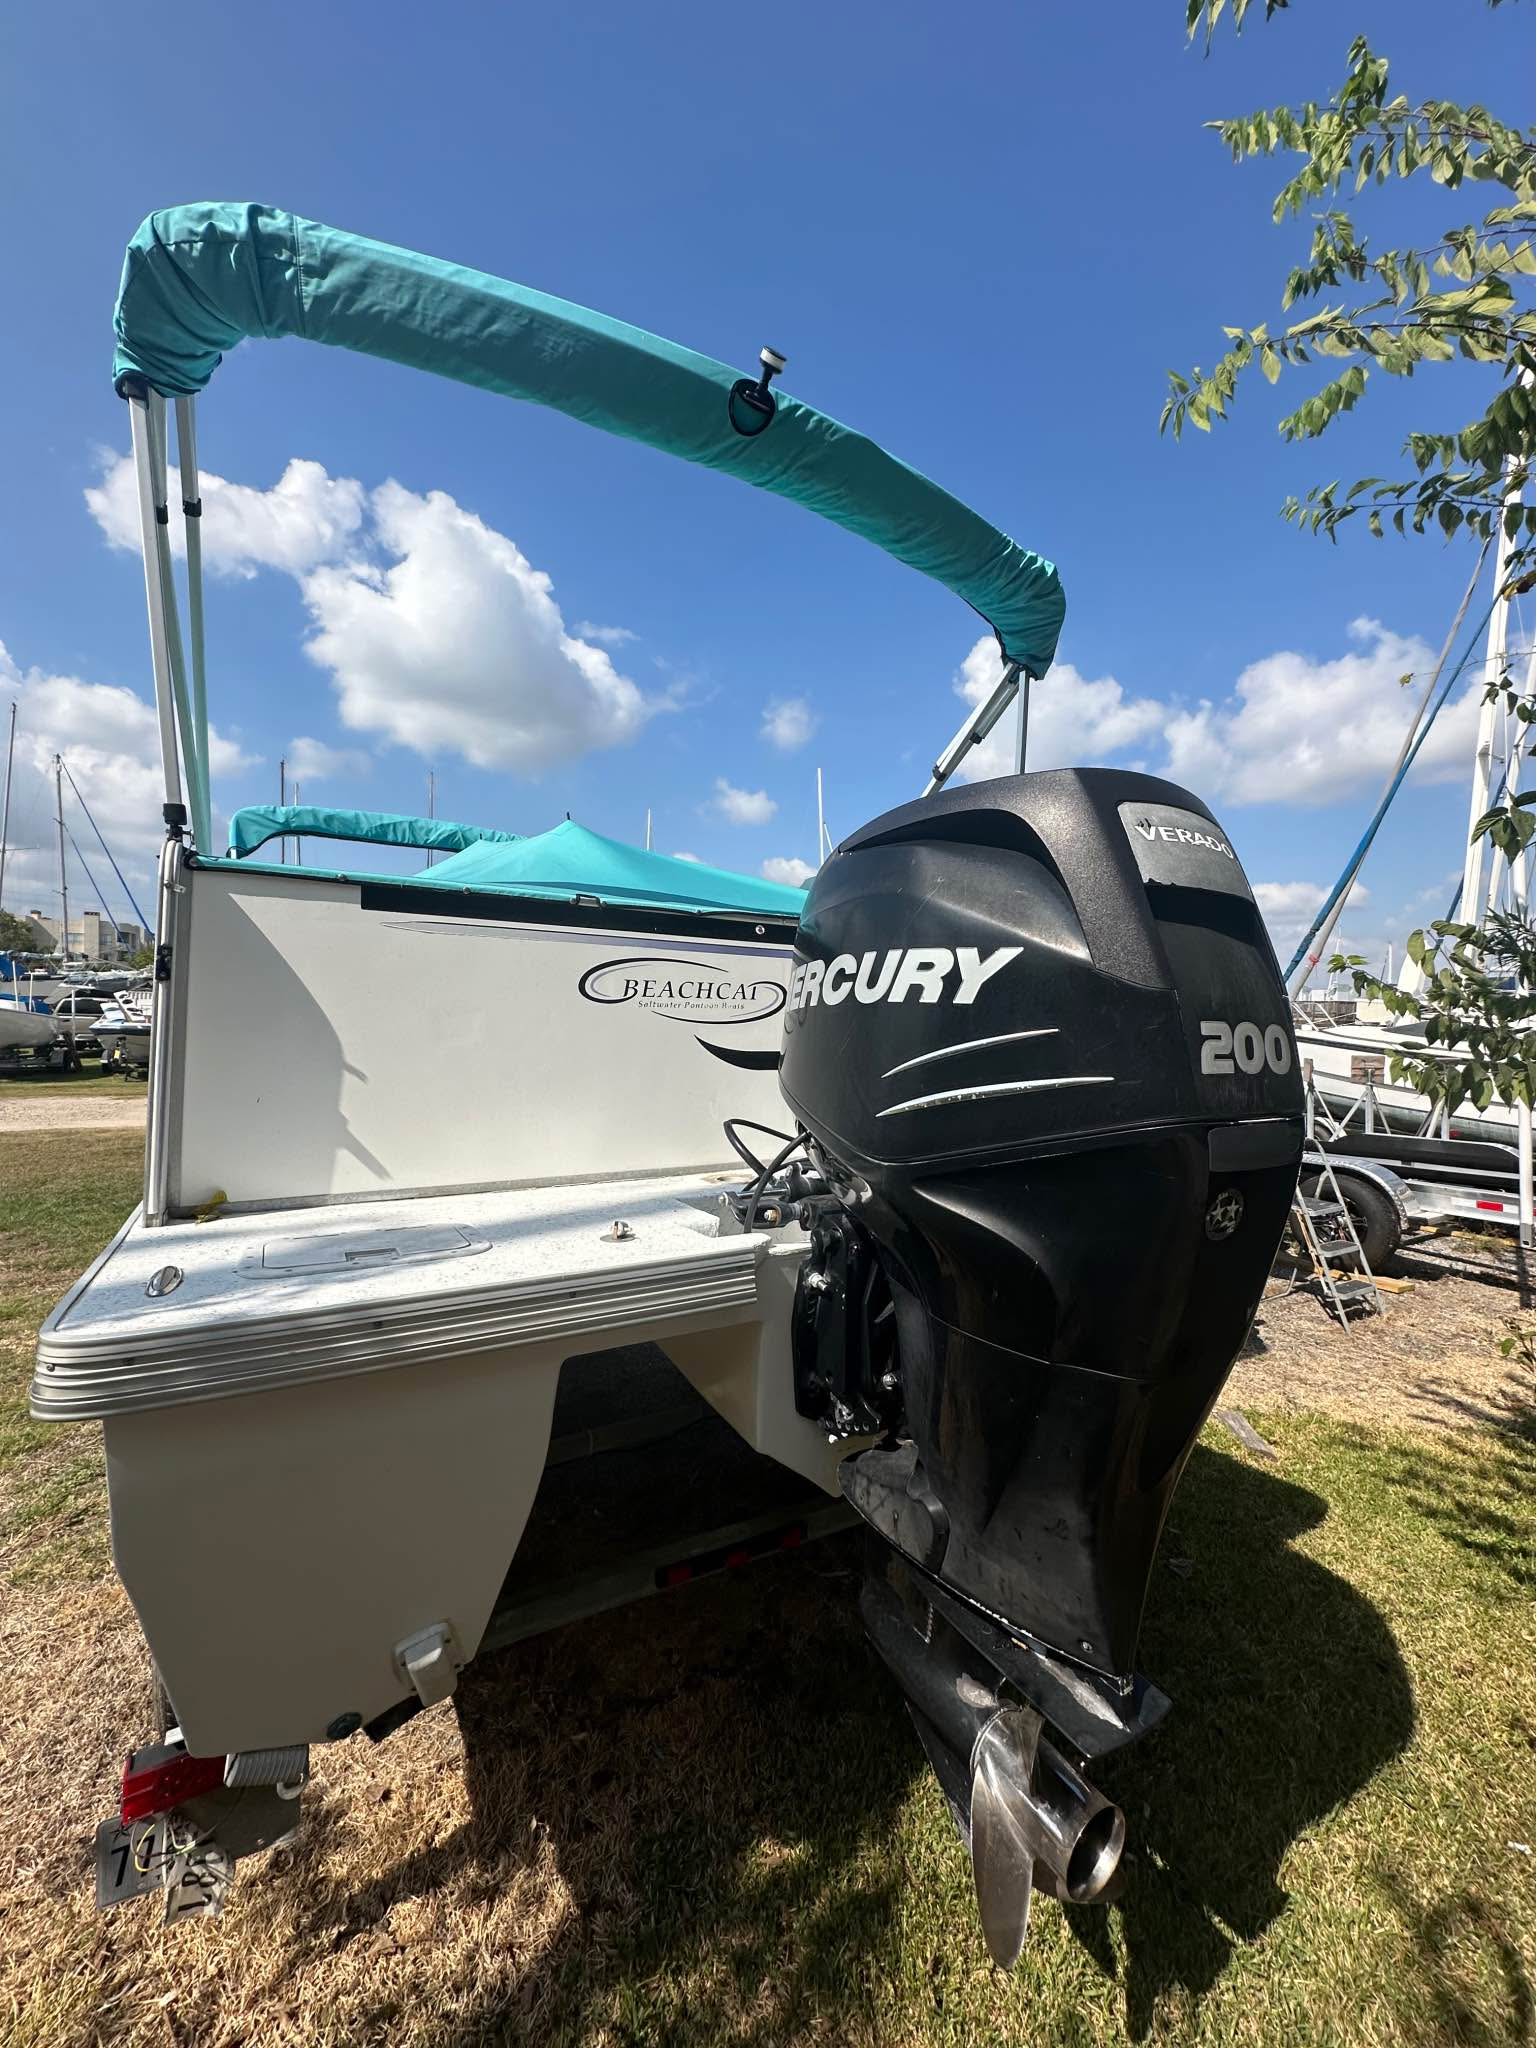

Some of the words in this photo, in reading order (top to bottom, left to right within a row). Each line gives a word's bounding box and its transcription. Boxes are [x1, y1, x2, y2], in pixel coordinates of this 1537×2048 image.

[1135, 826, 1234, 859] VERADO
[623, 979, 758, 1001] BEACHCAT
[789, 947, 1024, 1011] ERCURY
[638, 1000, 682, 1009] Saltwater
[1200, 1020, 1292, 1075] 200
